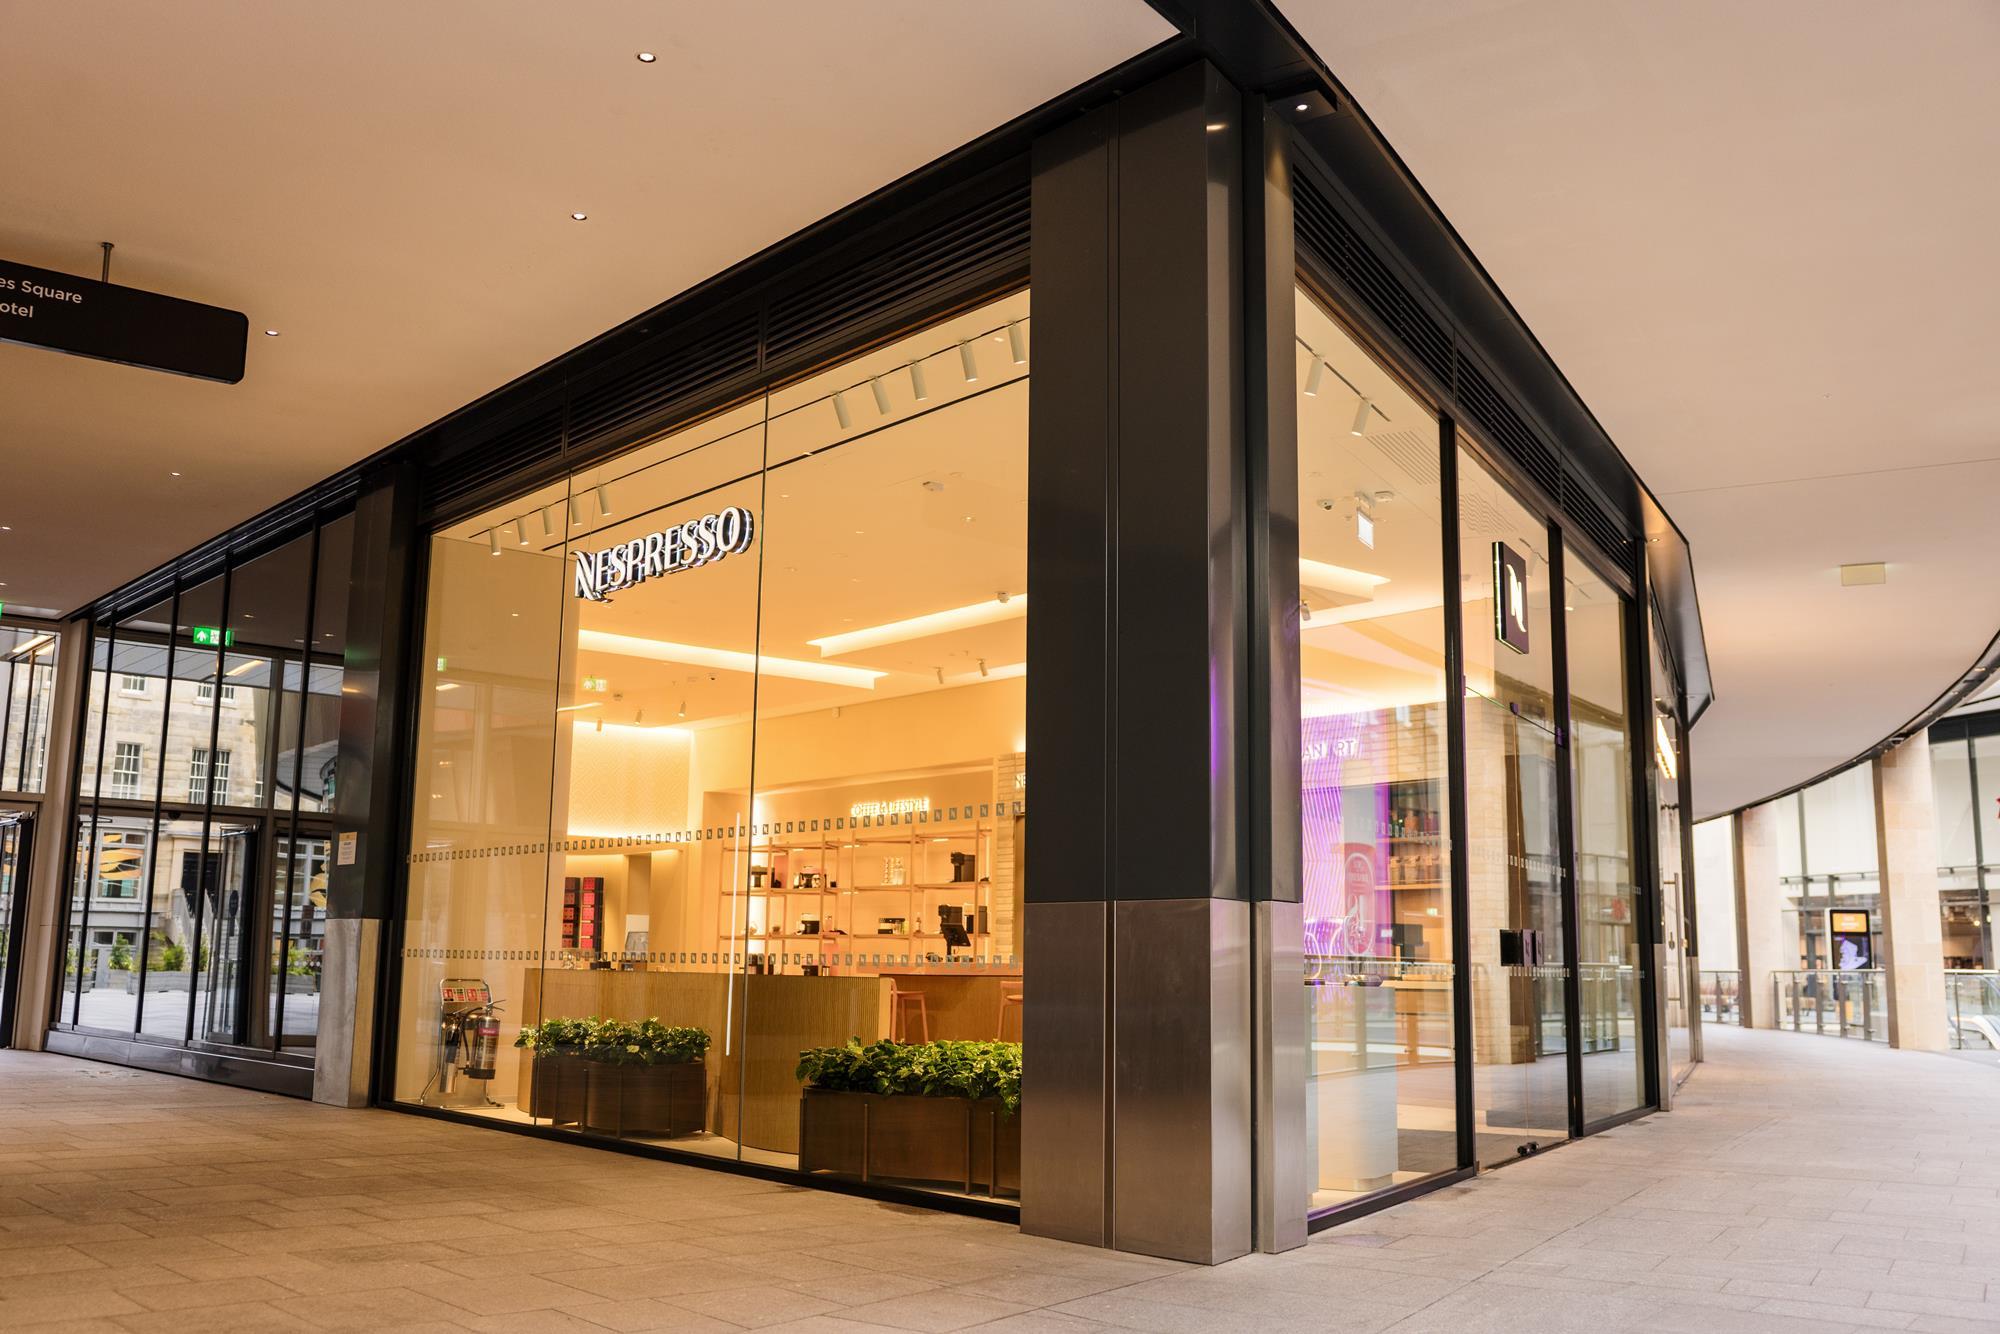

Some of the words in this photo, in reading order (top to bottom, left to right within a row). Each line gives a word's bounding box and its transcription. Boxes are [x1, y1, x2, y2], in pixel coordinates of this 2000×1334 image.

[21, 280, 83, 304] Square
[570, 506, 754, 602] NESPRESSO
[850, 803, 880, 817] OFFEE
